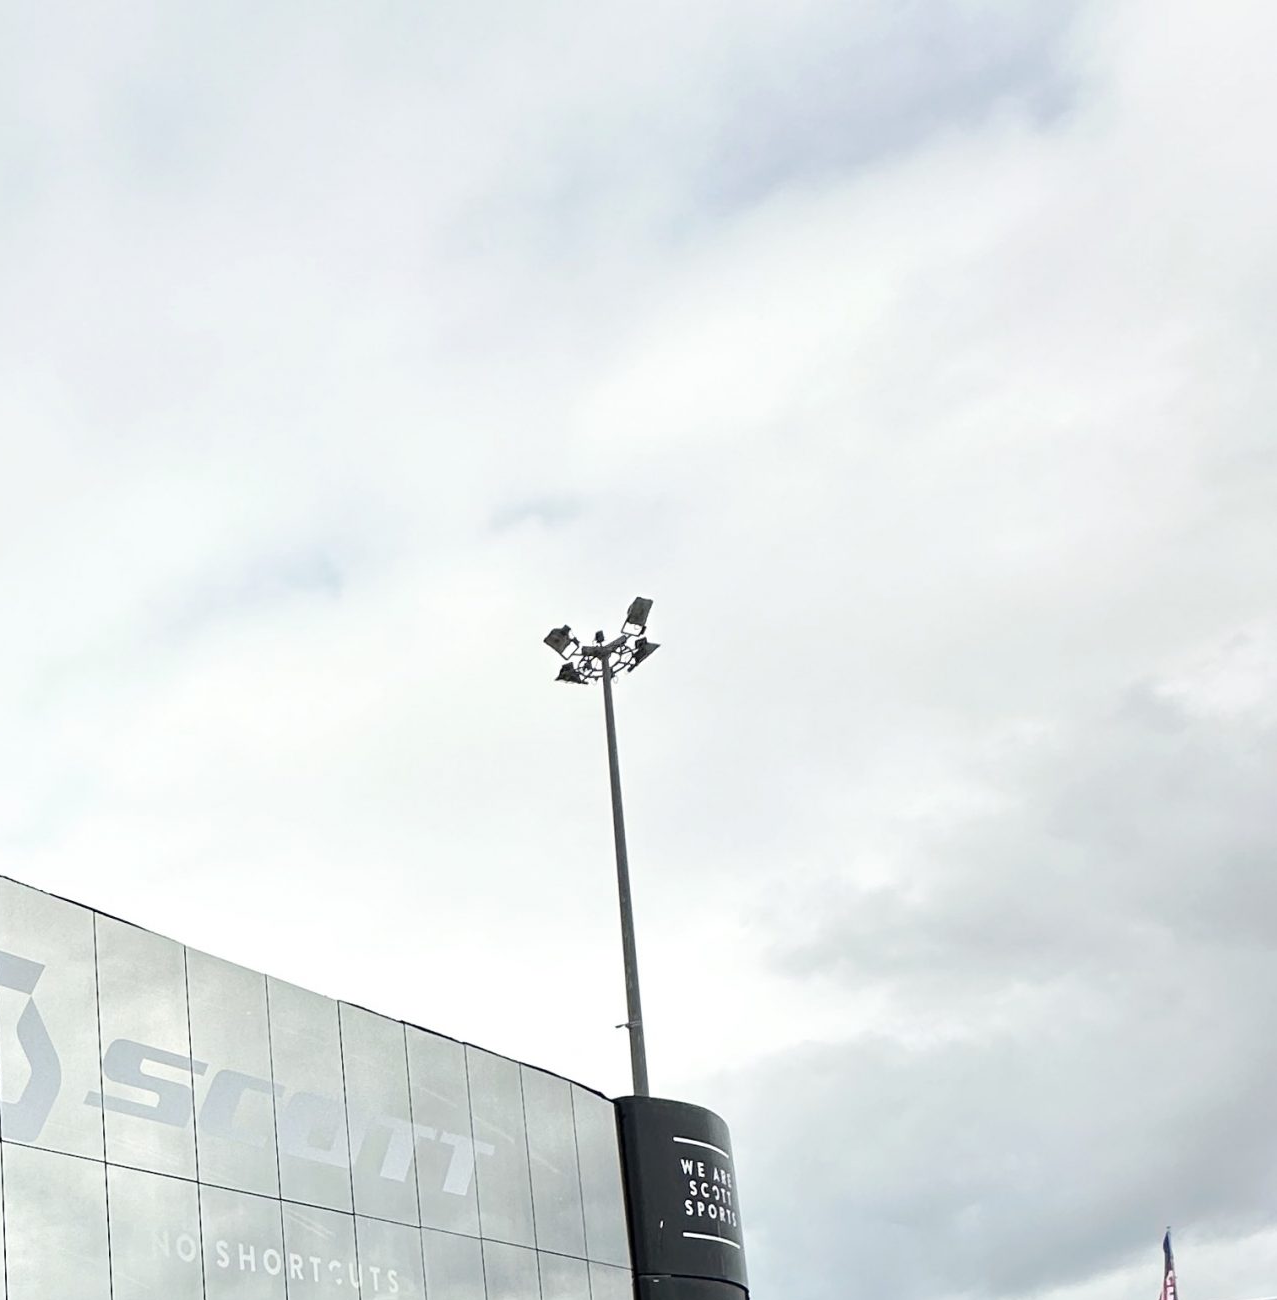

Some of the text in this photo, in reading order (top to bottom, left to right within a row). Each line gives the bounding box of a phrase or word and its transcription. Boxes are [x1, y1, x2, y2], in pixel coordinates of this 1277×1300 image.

[84, 1038, 494, 1197] SCOTT
[680, 1158, 732, 1189] WE ARE
[689, 1180, 732, 1206] SCOTT
[684, 1199, 737, 1227] SPORTS
[151, 1230, 399, 1294] NO SHORTCUTS
